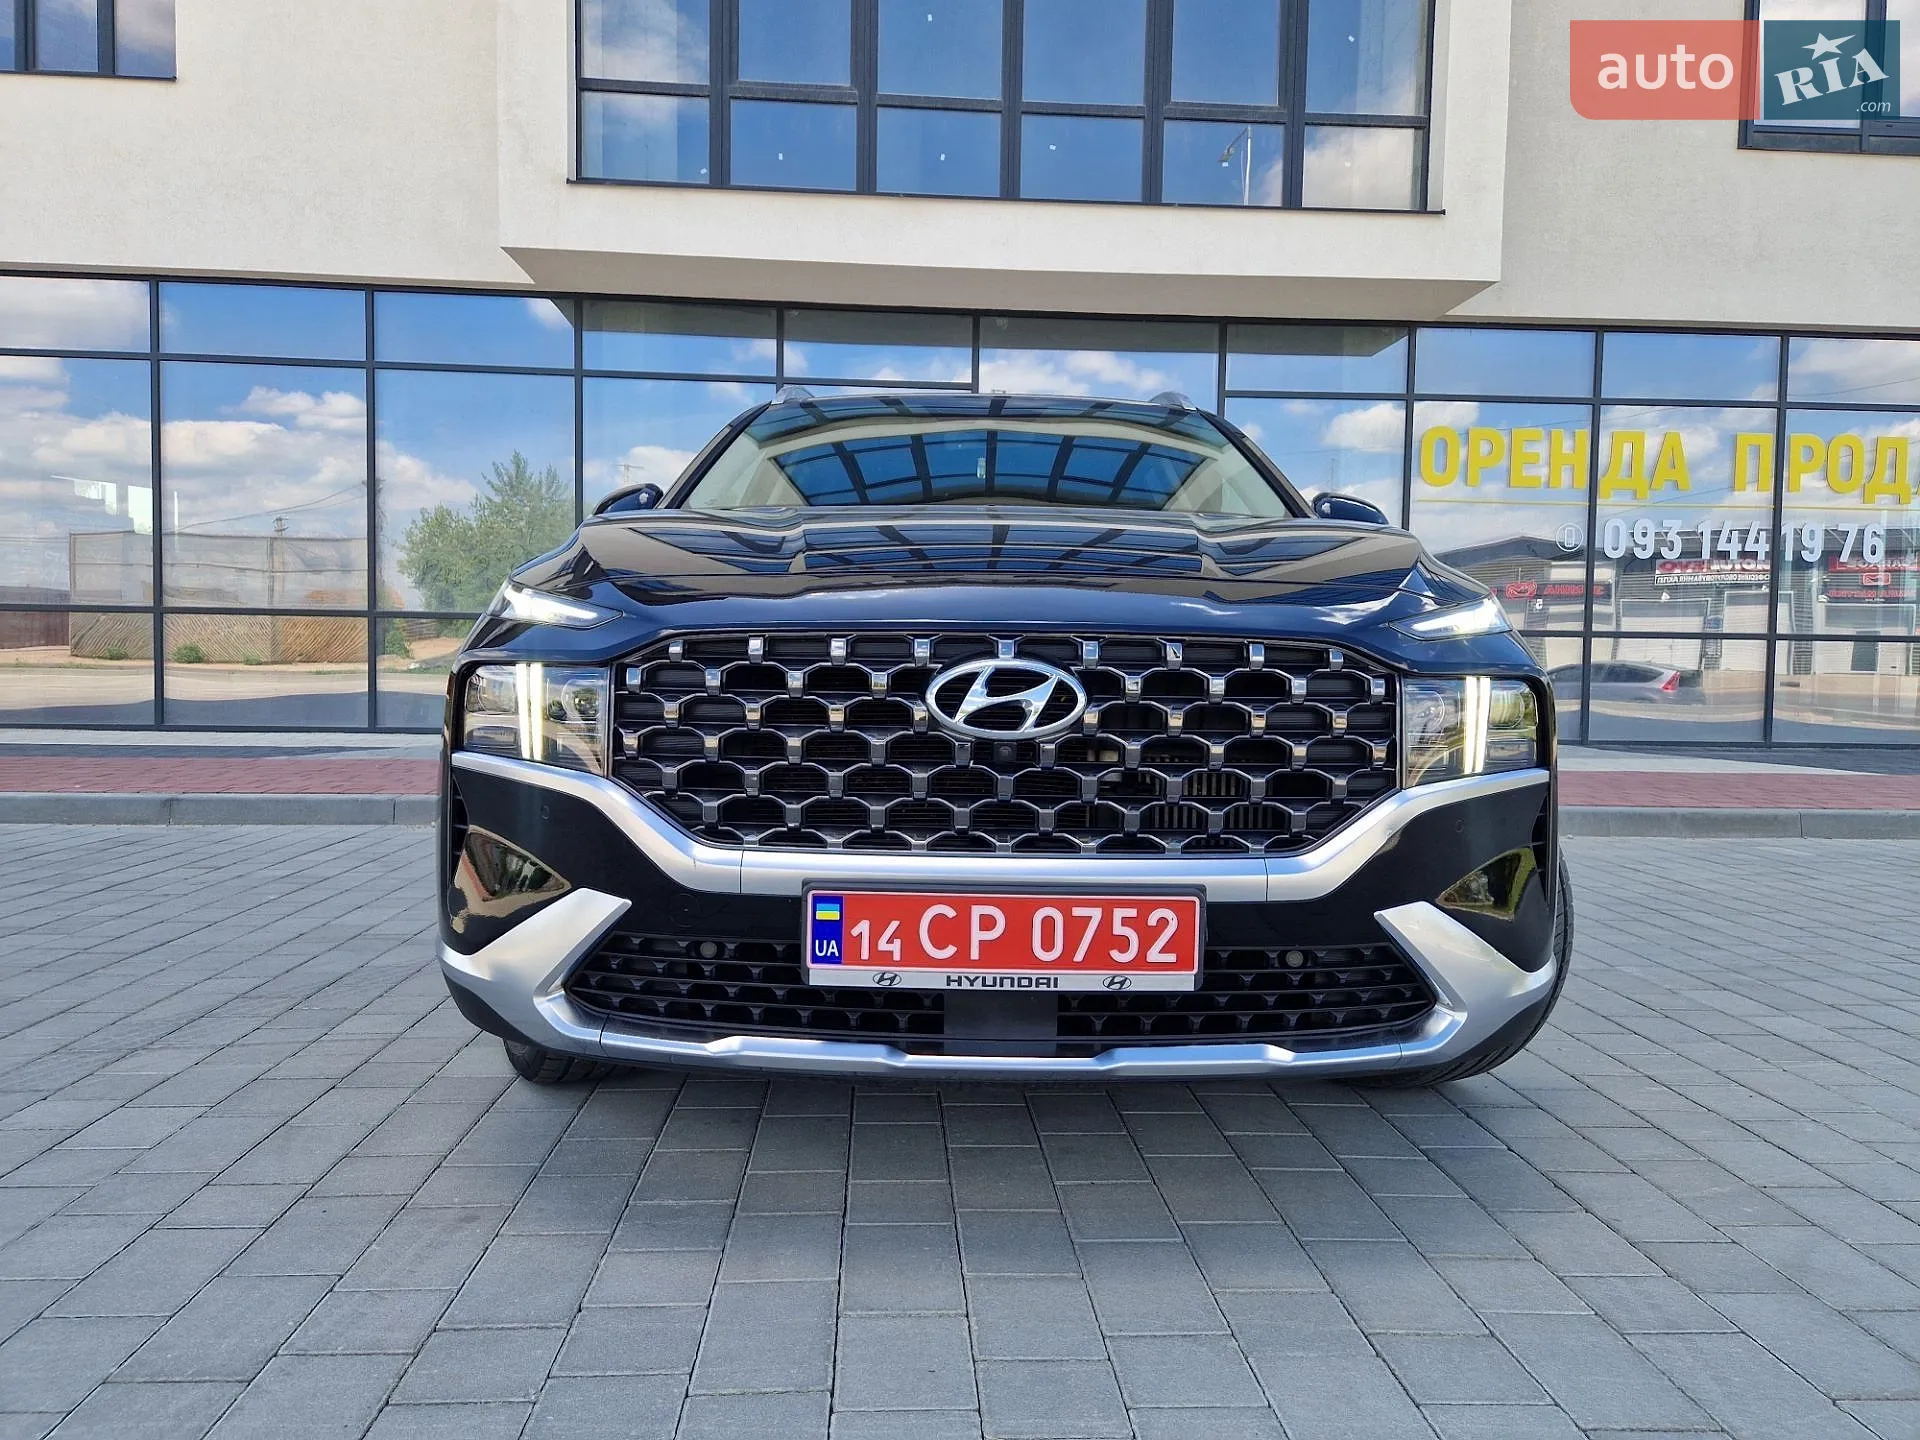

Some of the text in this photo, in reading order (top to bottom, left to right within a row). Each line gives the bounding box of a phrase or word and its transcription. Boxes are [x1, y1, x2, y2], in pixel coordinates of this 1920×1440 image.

[1420, 425, 1920, 504] ОРЕНДА ПРОД
[1603, 518, 1885, 564] 093 144 19 76
[815, 939, 839, 957] UA
[850, 904, 1178, 963] 14 CP 0752
[945, 974, 1059, 989] HYUNDAI
